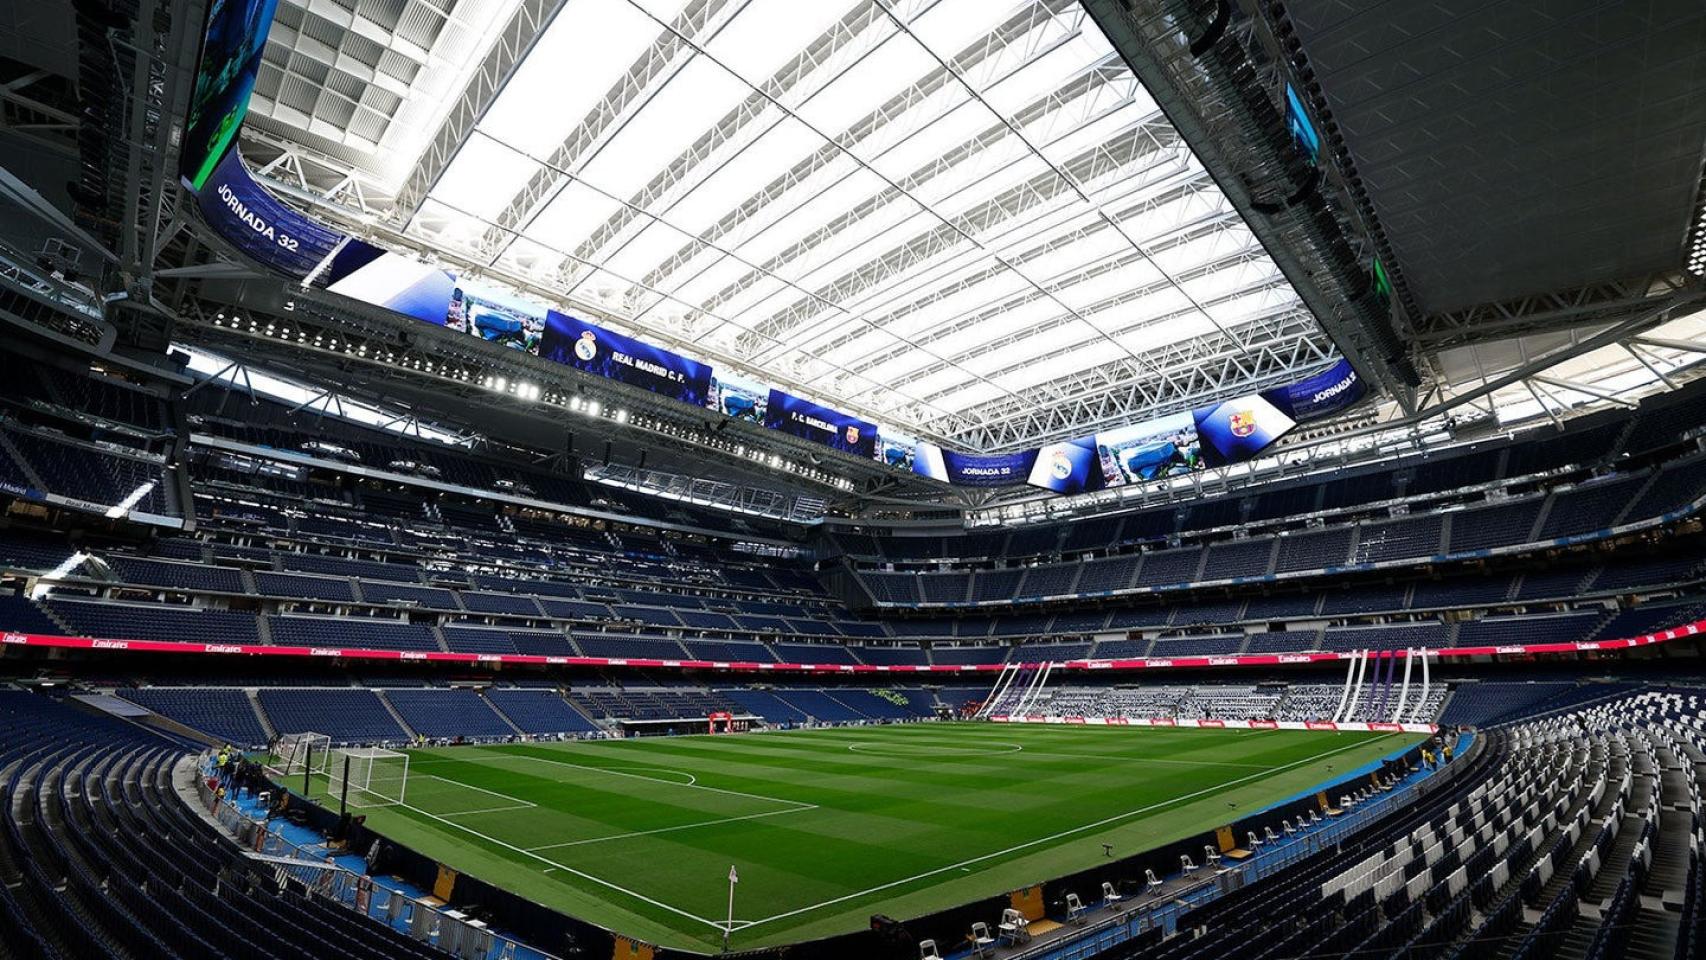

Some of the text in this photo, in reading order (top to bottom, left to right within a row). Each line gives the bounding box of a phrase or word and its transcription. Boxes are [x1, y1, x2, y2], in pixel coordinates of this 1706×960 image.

[217, 183, 299, 252] JORNADA 32
[611, 351, 685, 384] REAL MADRID C. F.
[1312, 377, 1353, 403] JORNADA
[961, 467, 1011, 475] JORNADA 32
[92, 639, 128, 649] Emirates
[205, 644, 242, 653] Emirates
[310, 647, 341, 656] Emirates
